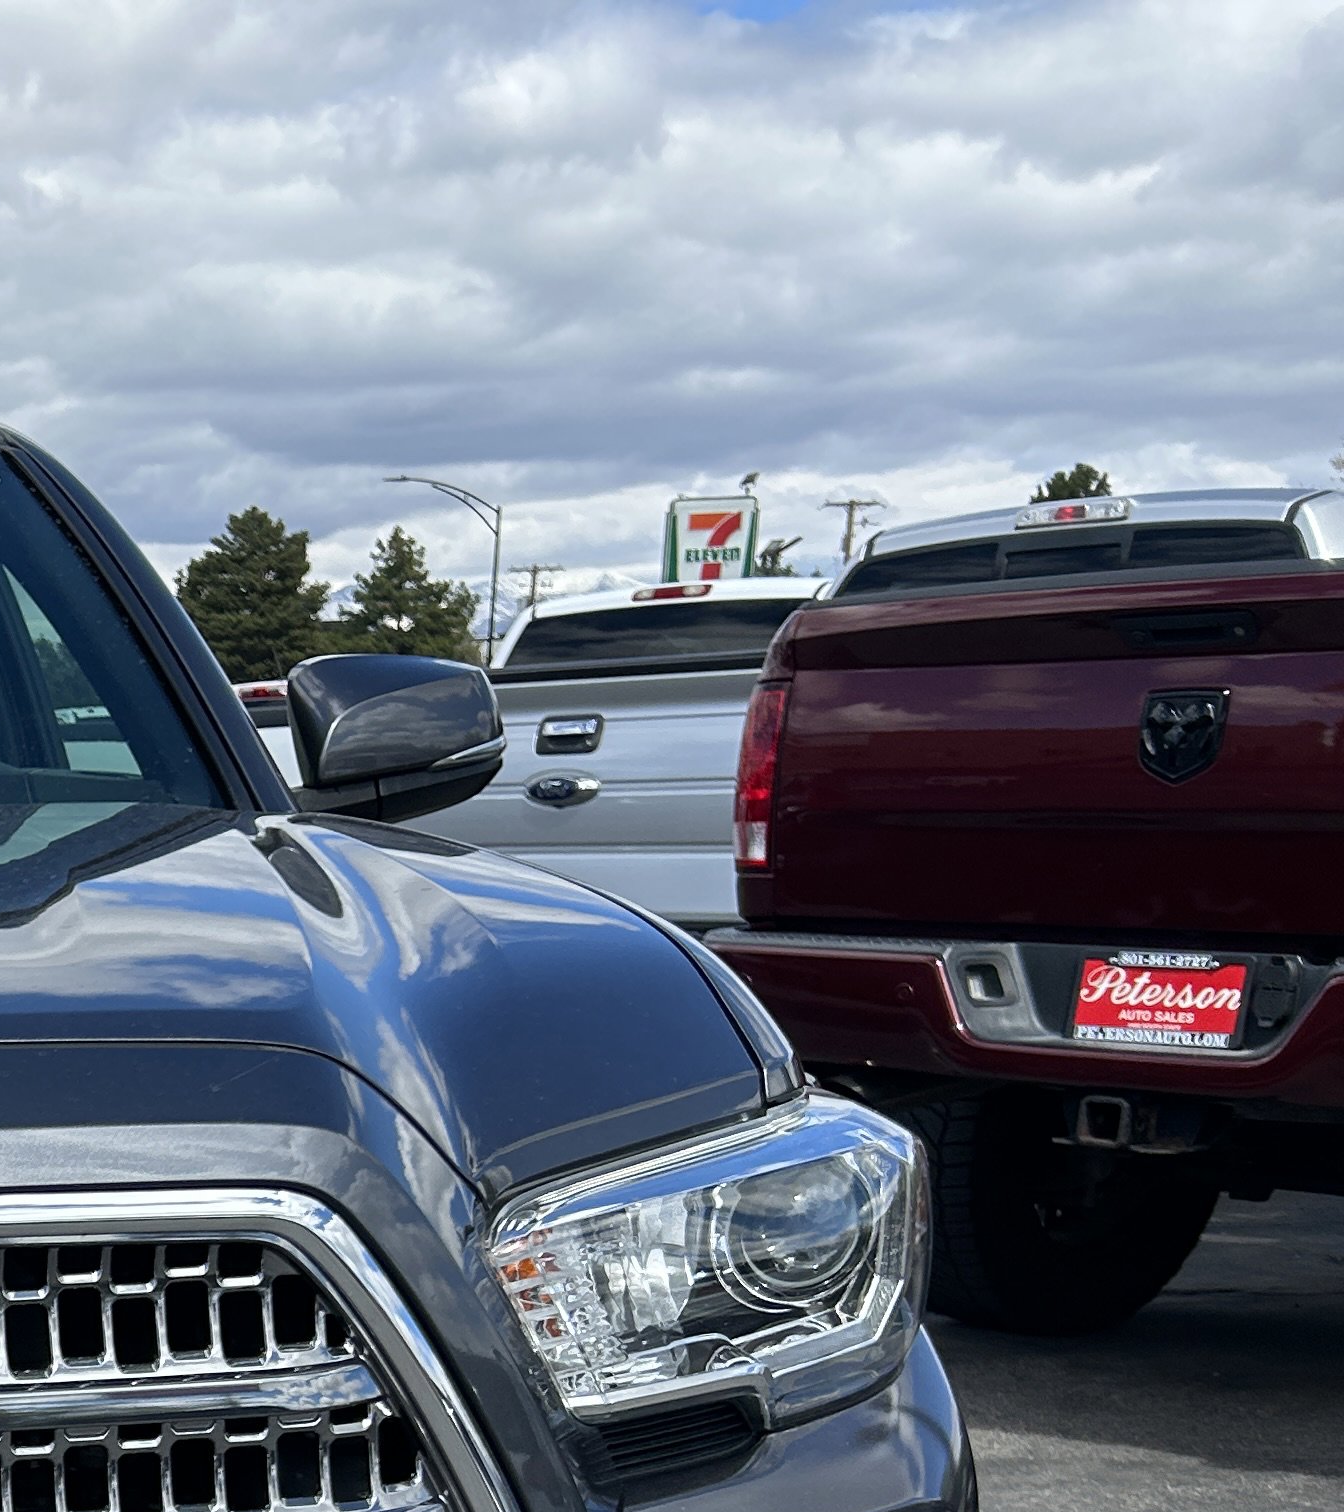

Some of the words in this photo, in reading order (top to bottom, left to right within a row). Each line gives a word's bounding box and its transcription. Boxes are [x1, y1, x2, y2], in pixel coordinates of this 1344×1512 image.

[1079, 964, 1242, 1011] Peterson
[1117, 1009, 1152, 1022] AUTO
[1154, 1010, 1195, 1024] SALES
